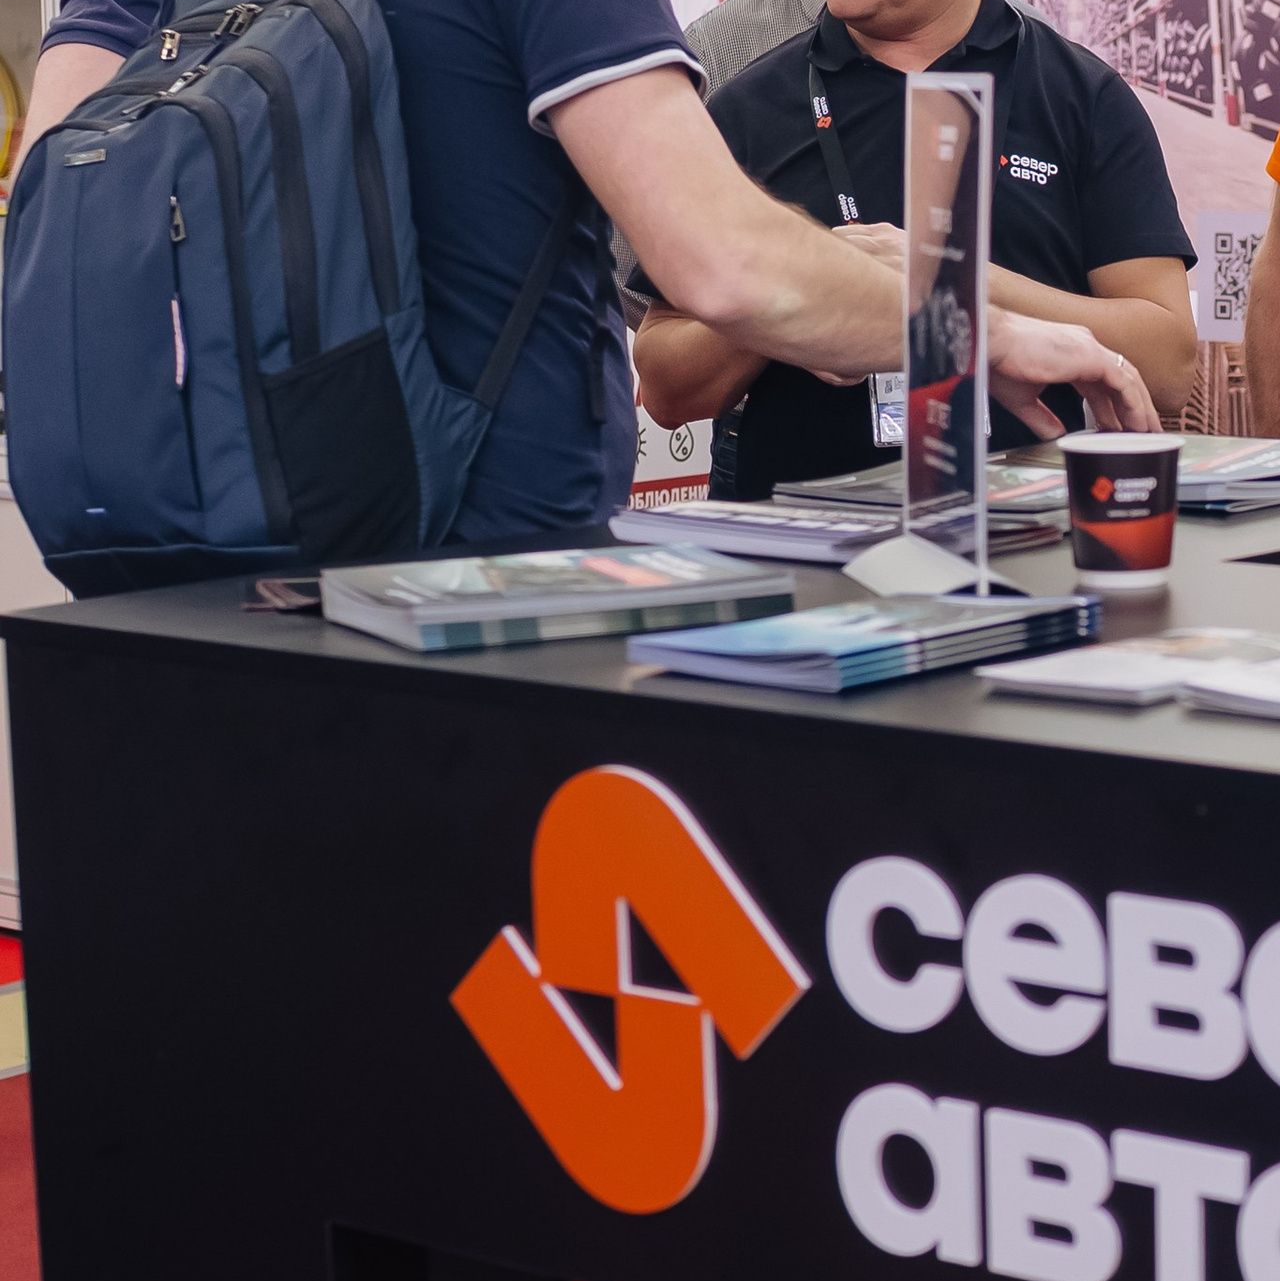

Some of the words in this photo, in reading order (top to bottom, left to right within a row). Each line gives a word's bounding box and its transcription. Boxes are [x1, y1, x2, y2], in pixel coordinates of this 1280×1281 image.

[1010, 154, 1059, 176] север
[1010, 167, 1048, 185] авто
[838, 193, 851, 221] север
[847, 196, 859, 219] авто
